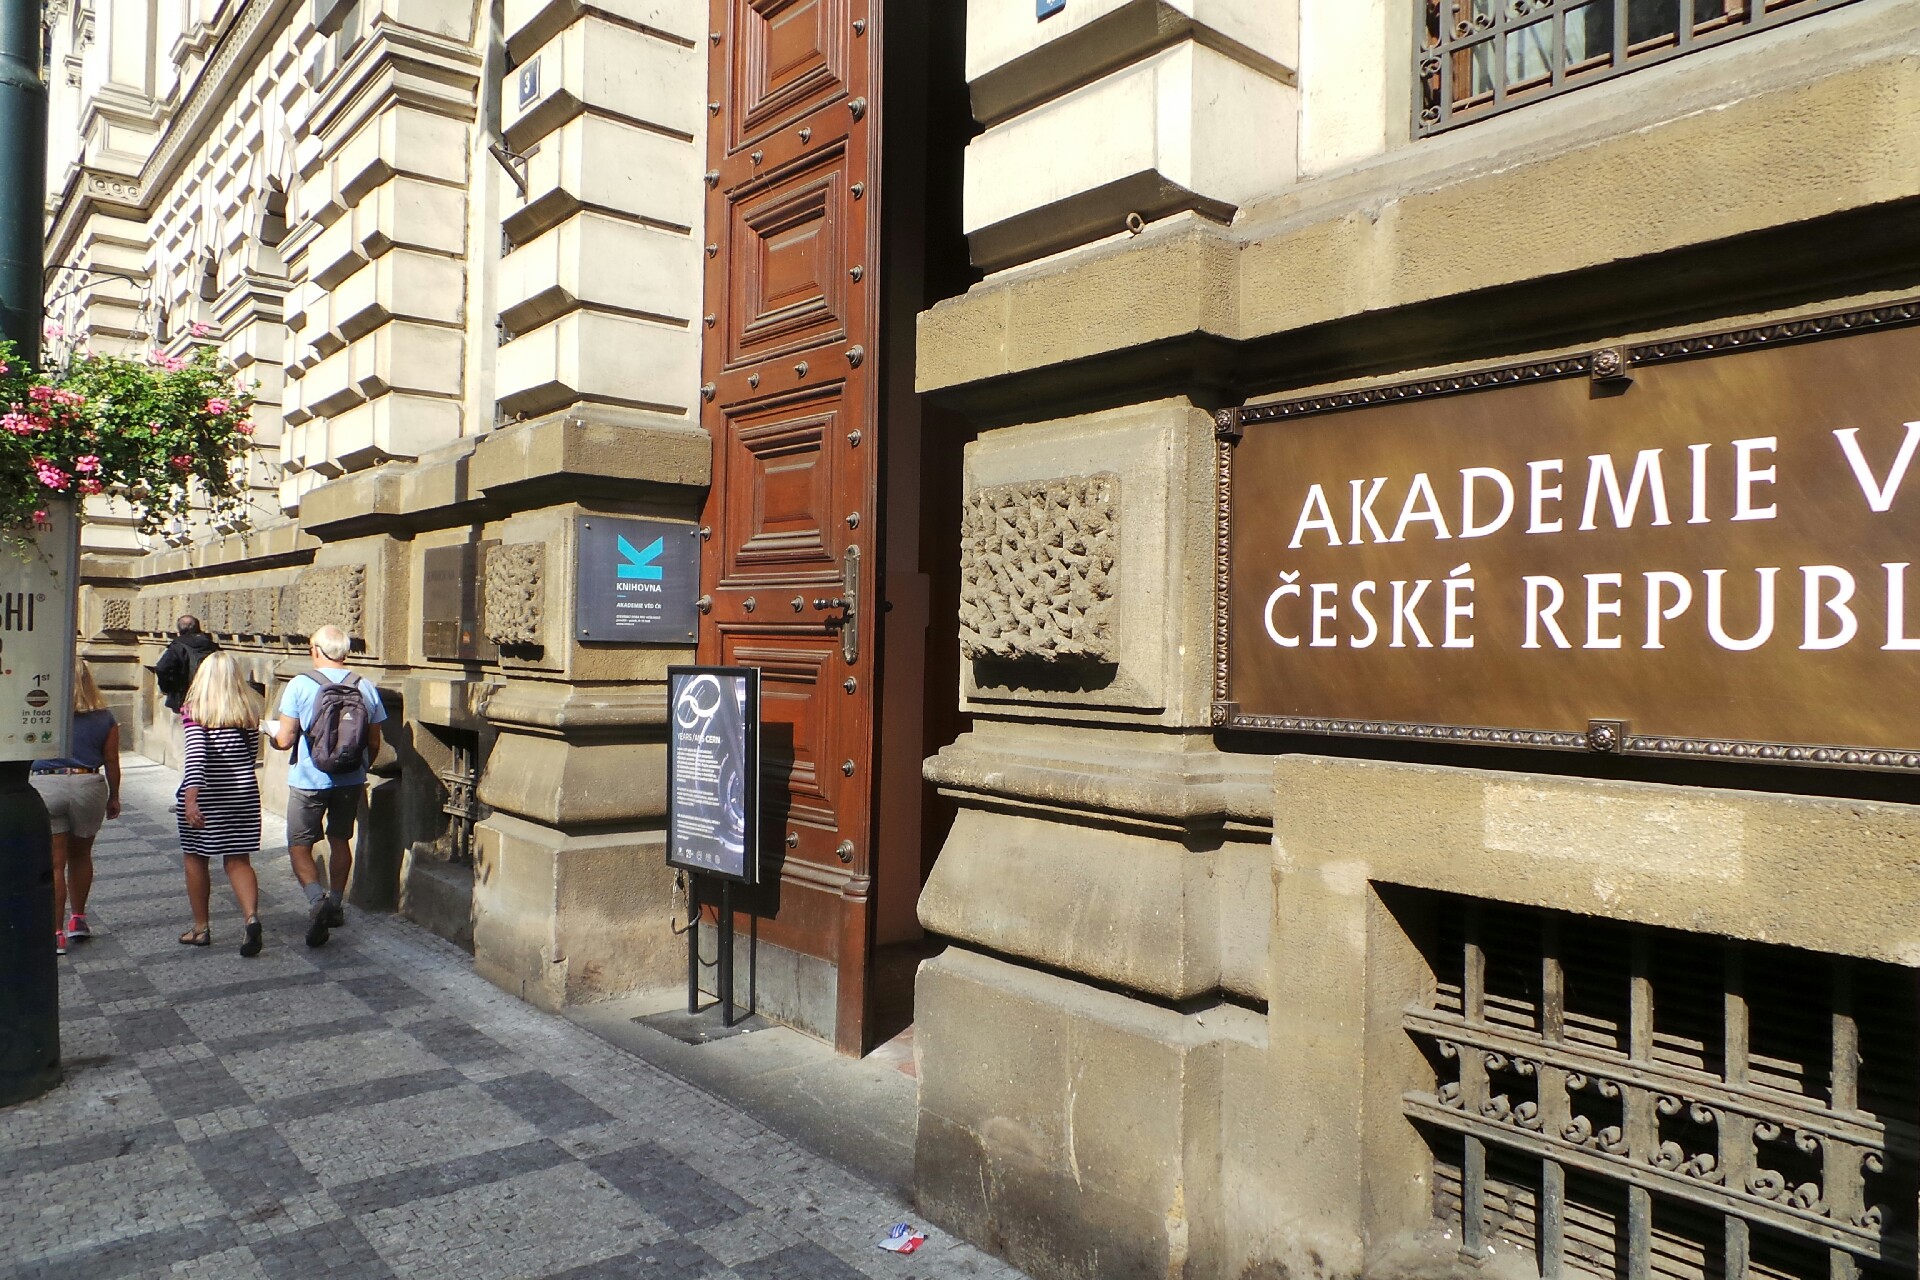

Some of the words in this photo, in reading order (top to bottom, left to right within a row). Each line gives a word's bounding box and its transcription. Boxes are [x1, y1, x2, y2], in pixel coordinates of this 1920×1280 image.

[524, 72, 531, 94] 3
[1288, 436, 1778, 549] AKADEMIE
[616, 582, 662, 593] KNIHOVNA
[1263, 562, 1476, 649] ČESKÉ
[22, 709, 31, 717] in
[33, 709, 52, 717] food
[705, 735, 721, 744] CERN
